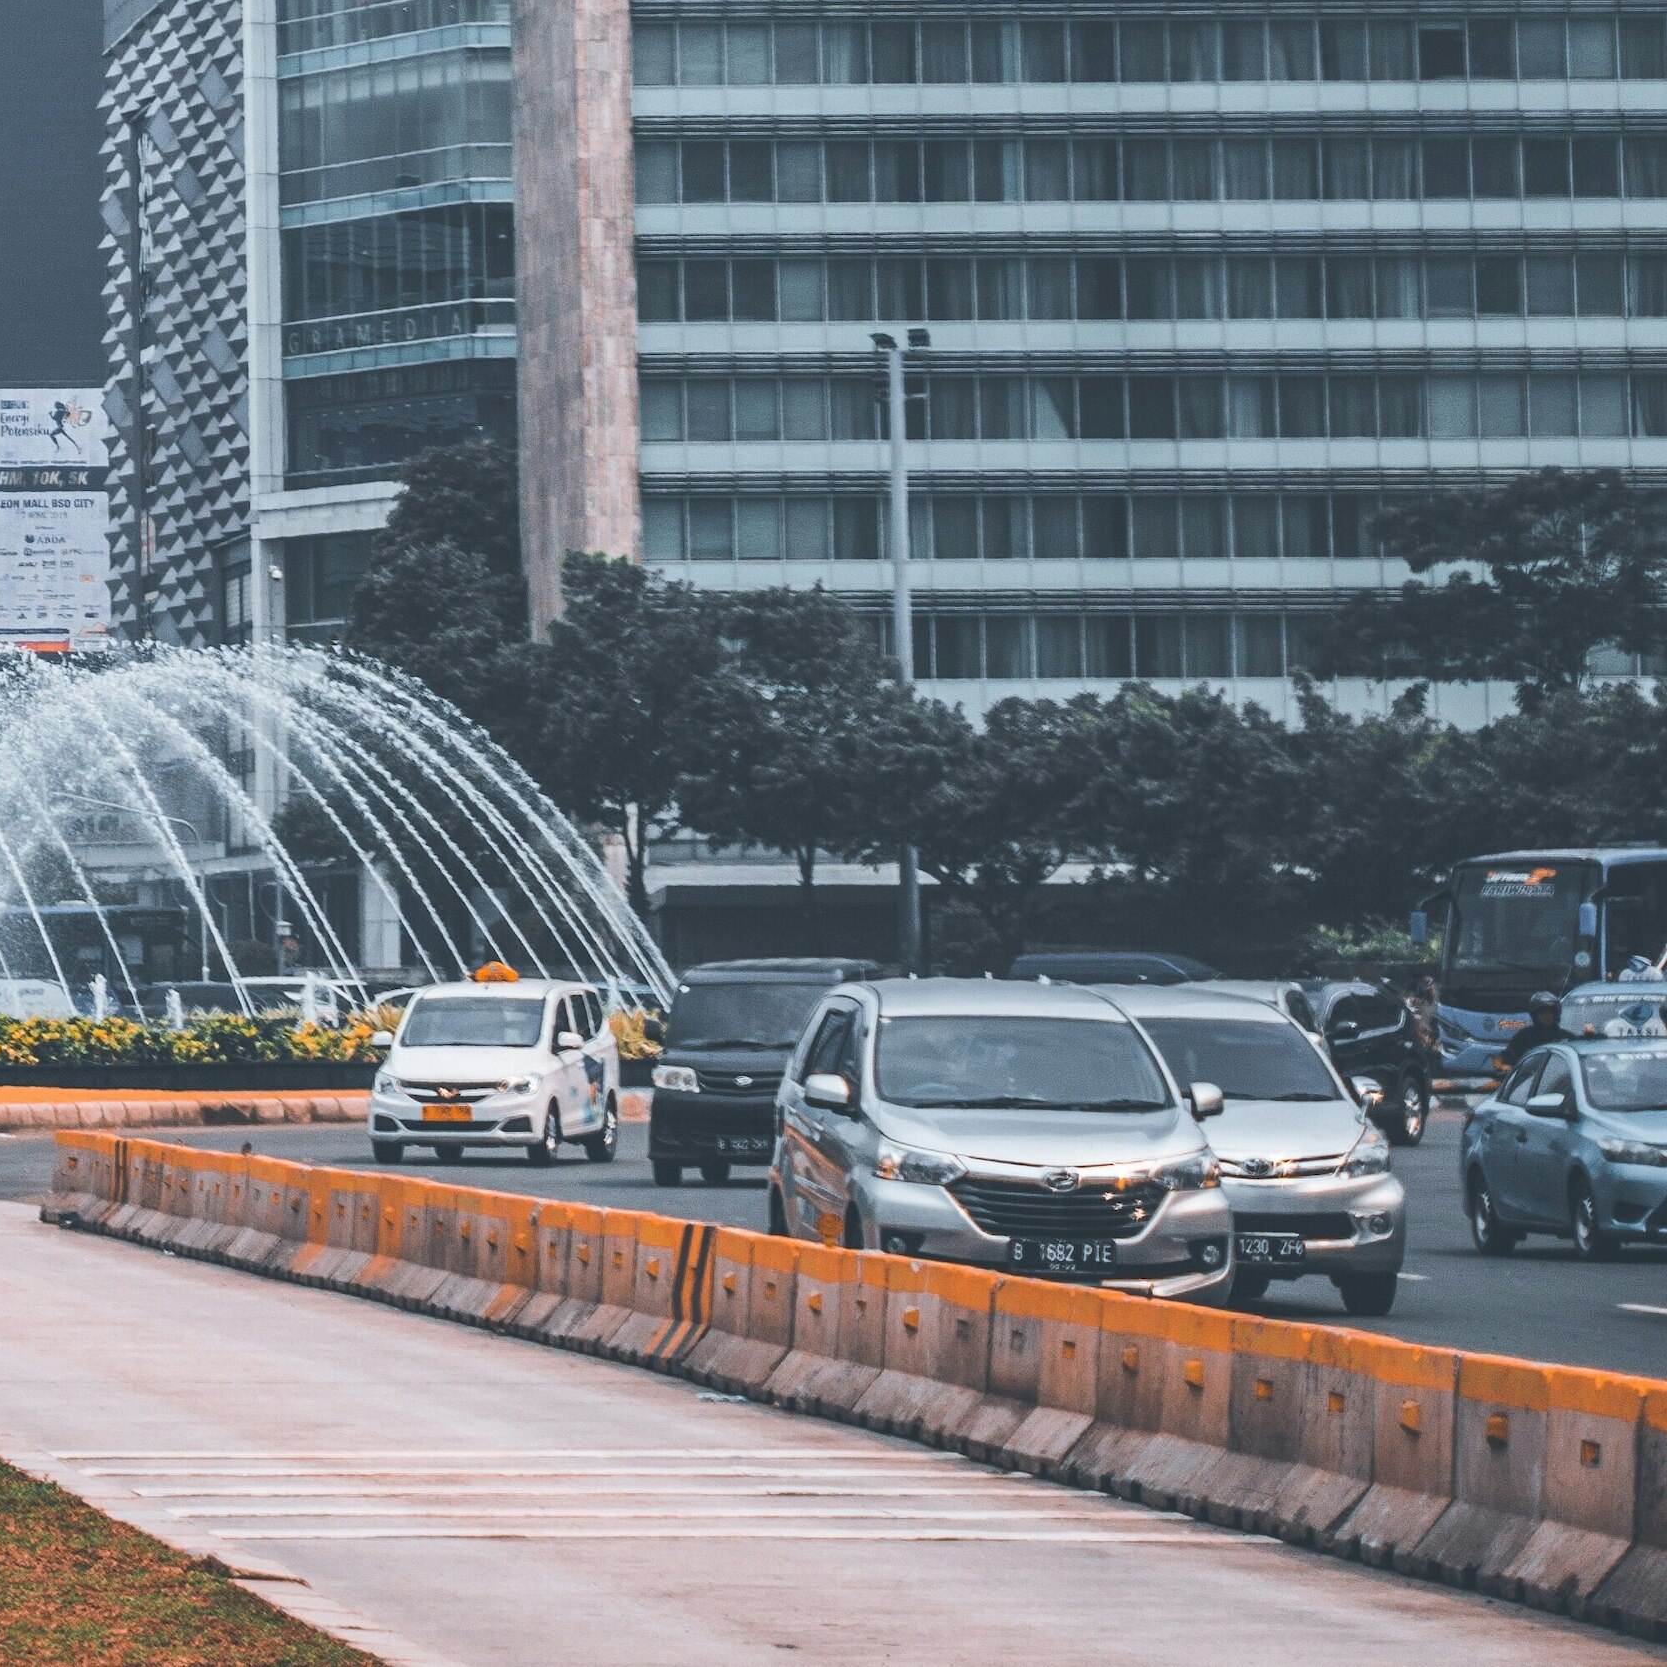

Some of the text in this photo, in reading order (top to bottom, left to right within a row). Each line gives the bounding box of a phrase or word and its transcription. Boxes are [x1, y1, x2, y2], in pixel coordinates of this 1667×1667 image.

[288, 312, 461, 354] GRAMEDIA
[22, 499, 49, 509] MALL
[73, 498, 95, 509] CITY
[1618, 1027, 1659, 1035] TAKSI
[1013, 1242, 1113, 1263] B 1682 PIE
